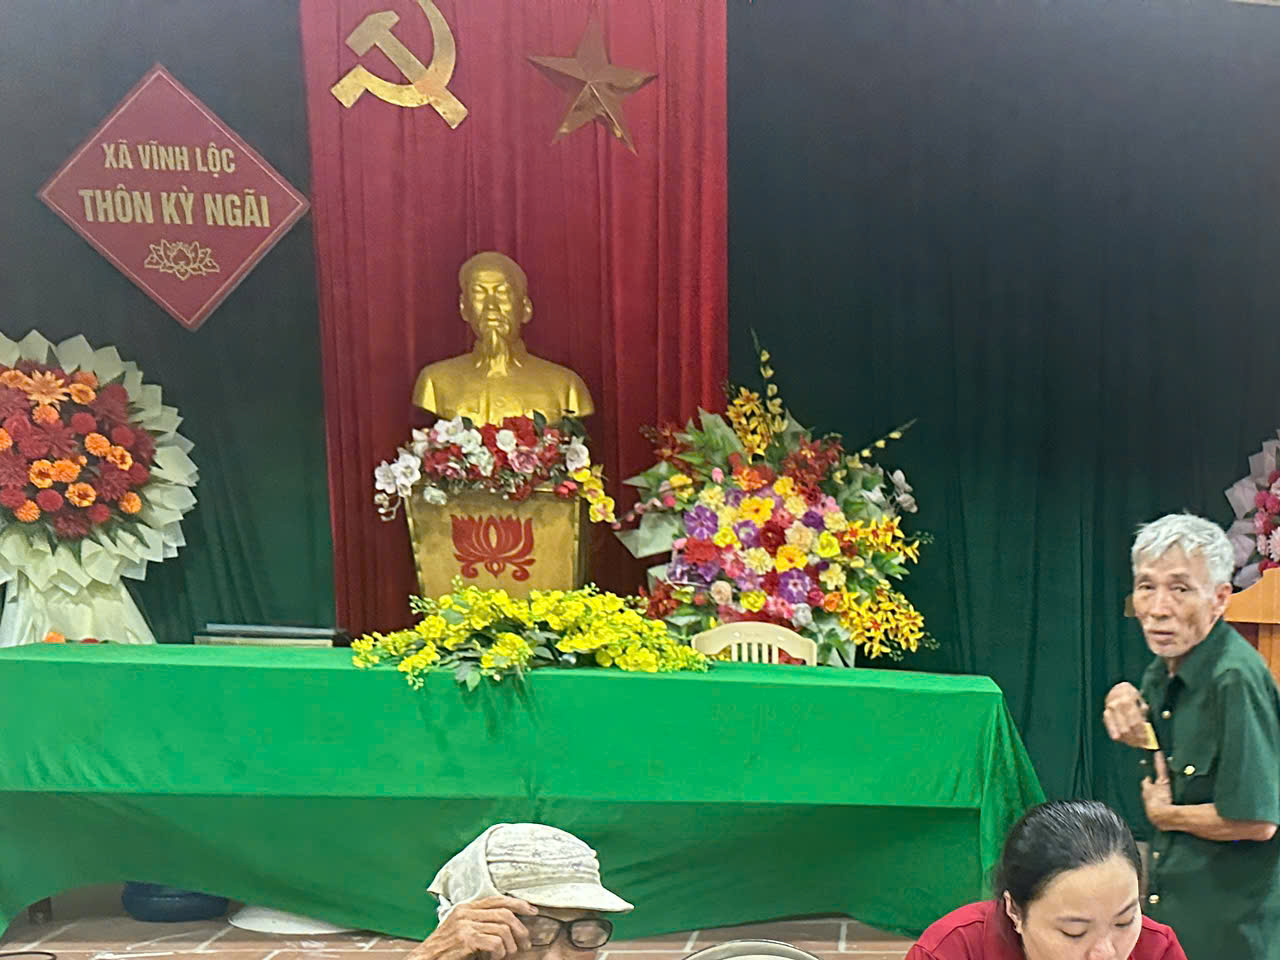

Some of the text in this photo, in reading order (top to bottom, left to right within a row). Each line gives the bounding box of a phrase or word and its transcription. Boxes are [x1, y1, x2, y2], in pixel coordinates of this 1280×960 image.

[102, 139, 235, 178] XÃ VĨNH LỘC
[79, 184, 270, 227] THÔN KỲ NGÃI
